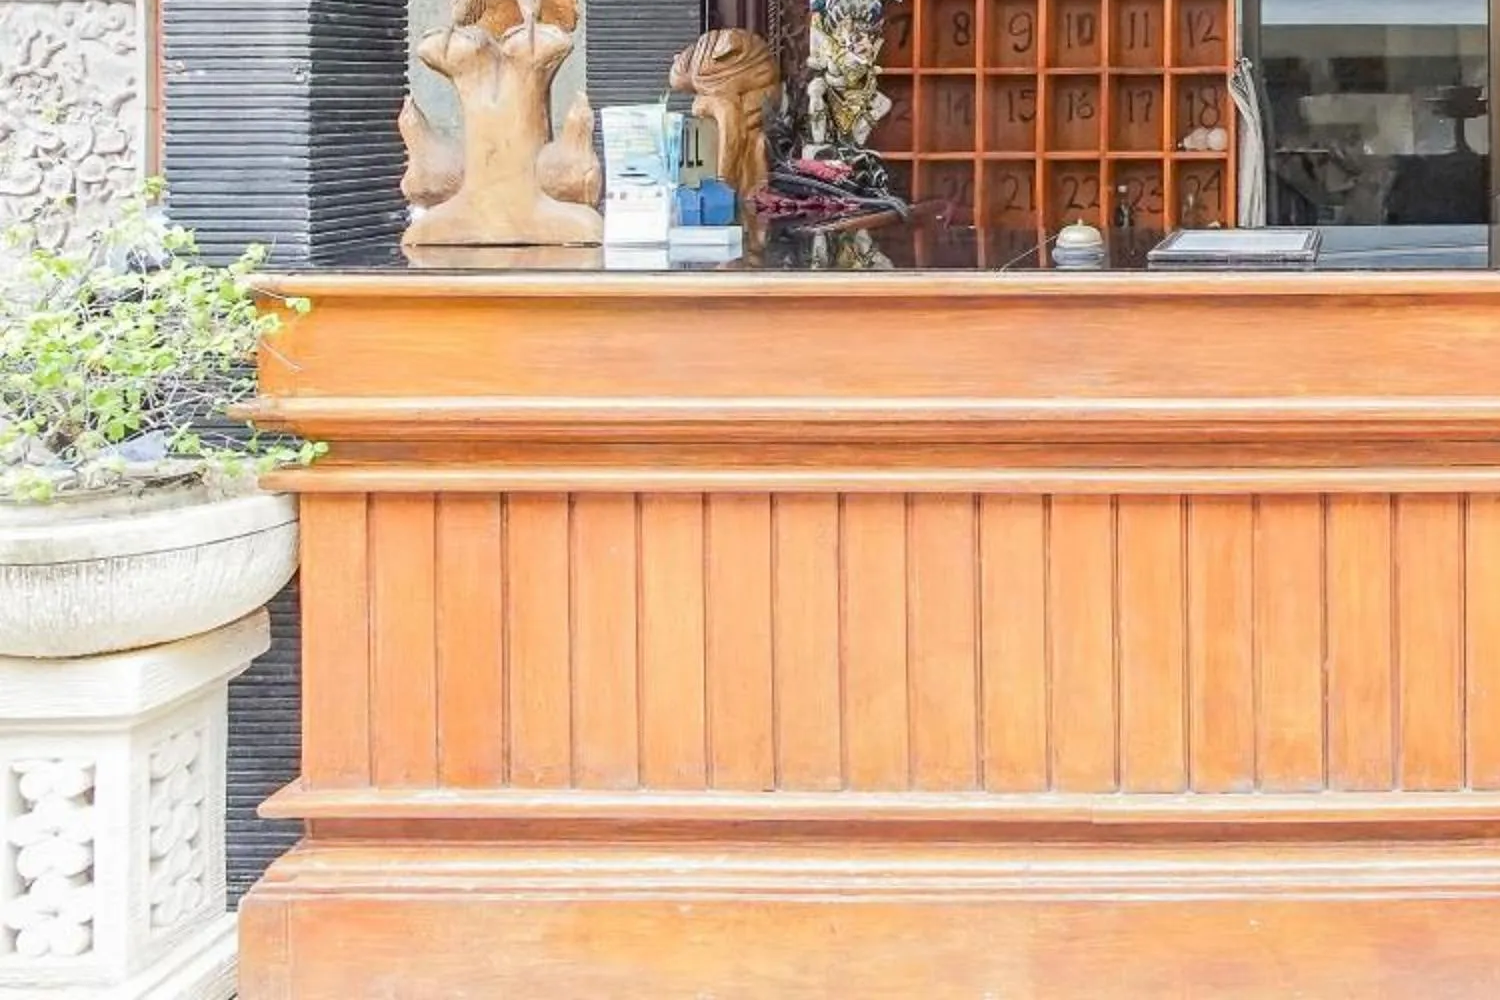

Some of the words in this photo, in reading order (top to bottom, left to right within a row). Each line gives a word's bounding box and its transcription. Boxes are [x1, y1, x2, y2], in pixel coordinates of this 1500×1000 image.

[886, 12, 913, 49] 7
[953, 10, 971, 47] 8
[1008, 10, 1033, 53] 9
[1066, 11, 1097, 49] 10
[1129, 10, 1150, 50] 11
[1186, 9, 1224, 49] 12
[1007, 88, 1037, 124] 15
[1067, 89, 1095, 123] 16
[1128, 89, 1154, 124] 17
[1186, 84, 1221, 129] 18
[1001, 173, 1037, 211] 21
[1061, 174, 1101, 210] 22
[1127, 174, 1164, 214] 23
[1185, 169, 1222, 213] 24
